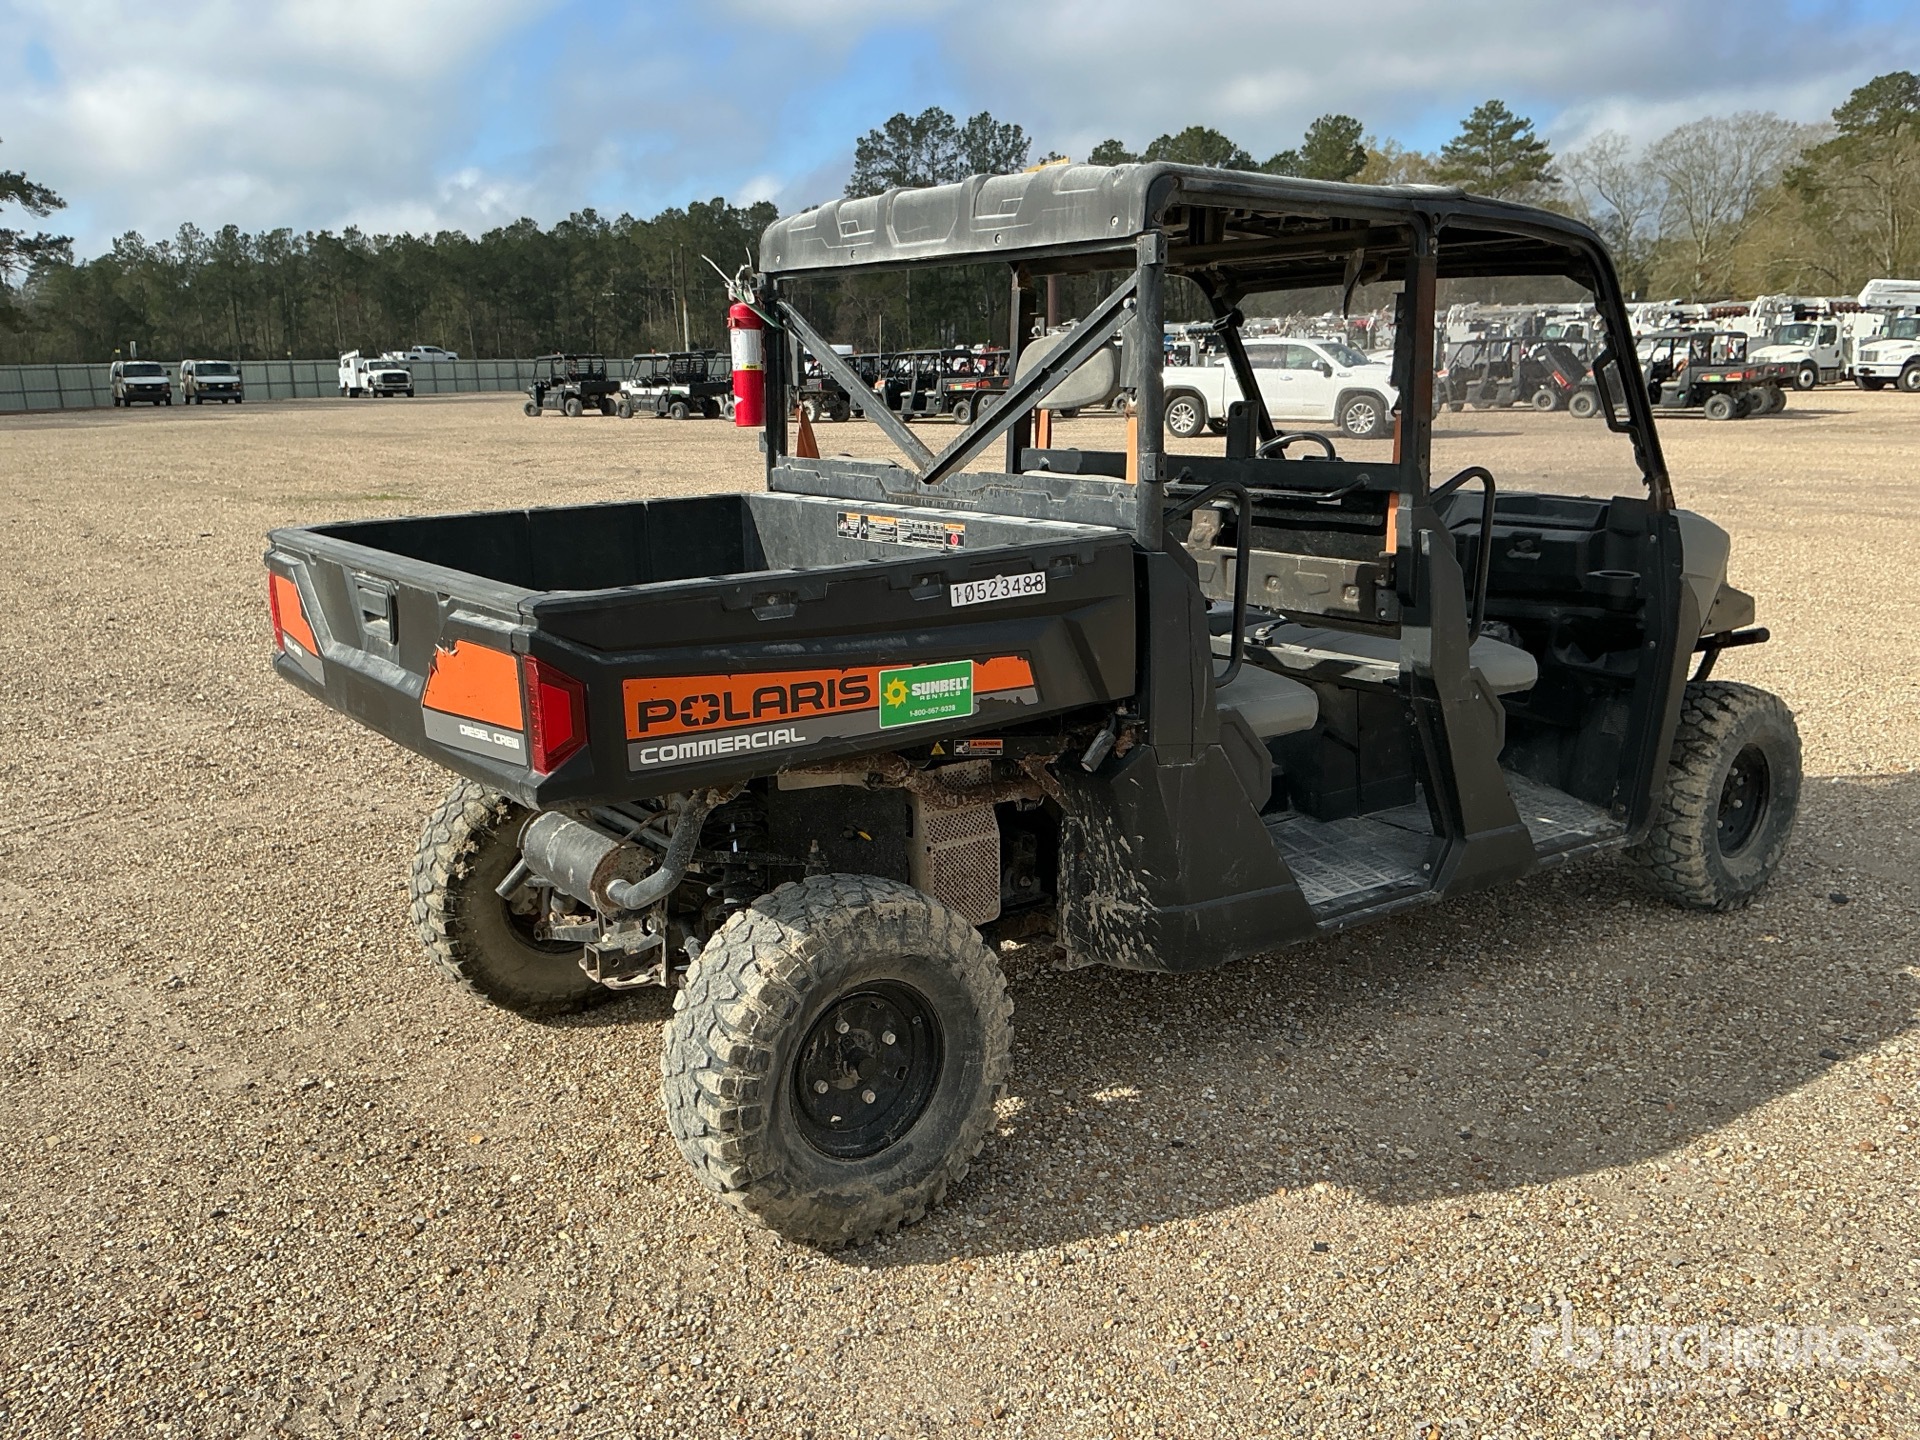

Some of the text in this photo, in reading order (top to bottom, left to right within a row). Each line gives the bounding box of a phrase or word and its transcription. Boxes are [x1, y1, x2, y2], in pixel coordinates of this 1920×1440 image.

[954, 574, 1044, 604] 10523488
[911, 677, 970, 696] SUNBELT
[920, 690, 961, 701] RENTALS
[638, 675, 871, 732] POLARIS
[459, 724, 520, 749] DIESEL CREW
[640, 727, 806, 765] COMMERCIAL
